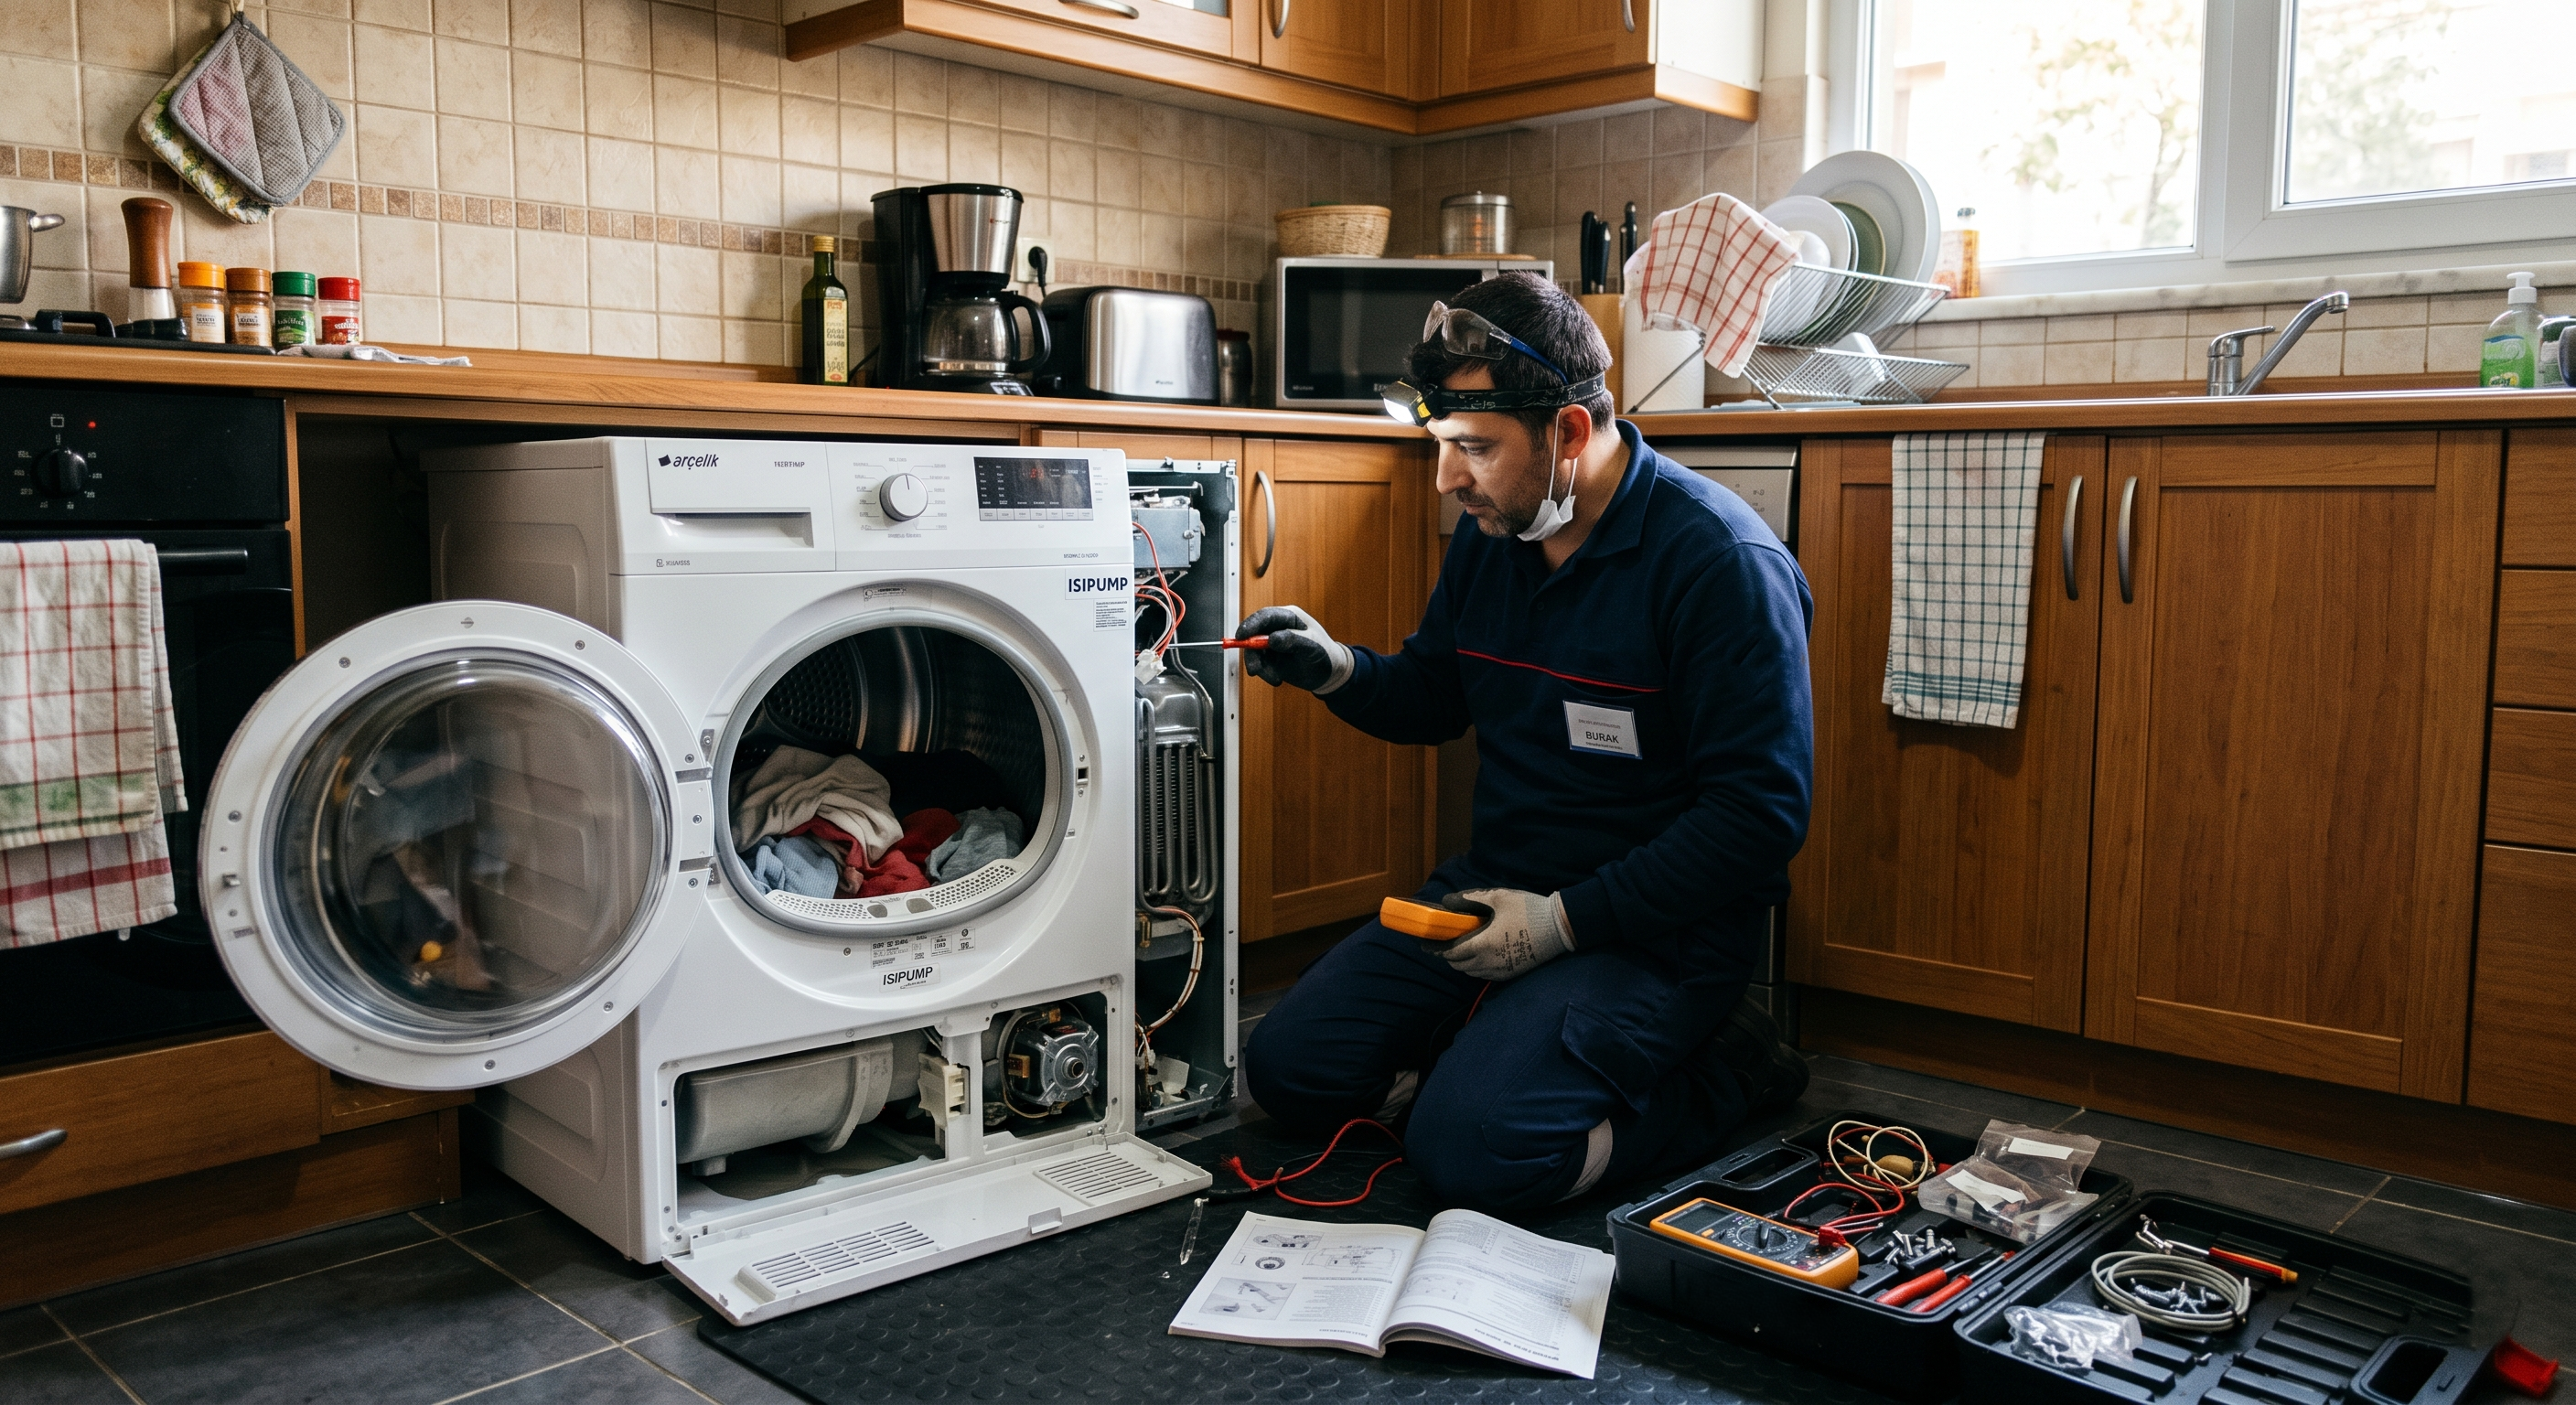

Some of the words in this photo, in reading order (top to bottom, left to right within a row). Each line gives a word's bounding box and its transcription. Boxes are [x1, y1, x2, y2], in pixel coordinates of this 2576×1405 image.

[672, 454, 719, 470] arçelik
[1068, 577, 1128, 593] ISIPUMP
[1585, 731, 1619, 744] BURAK
[883, 966, 933, 986] ISIPUMP
